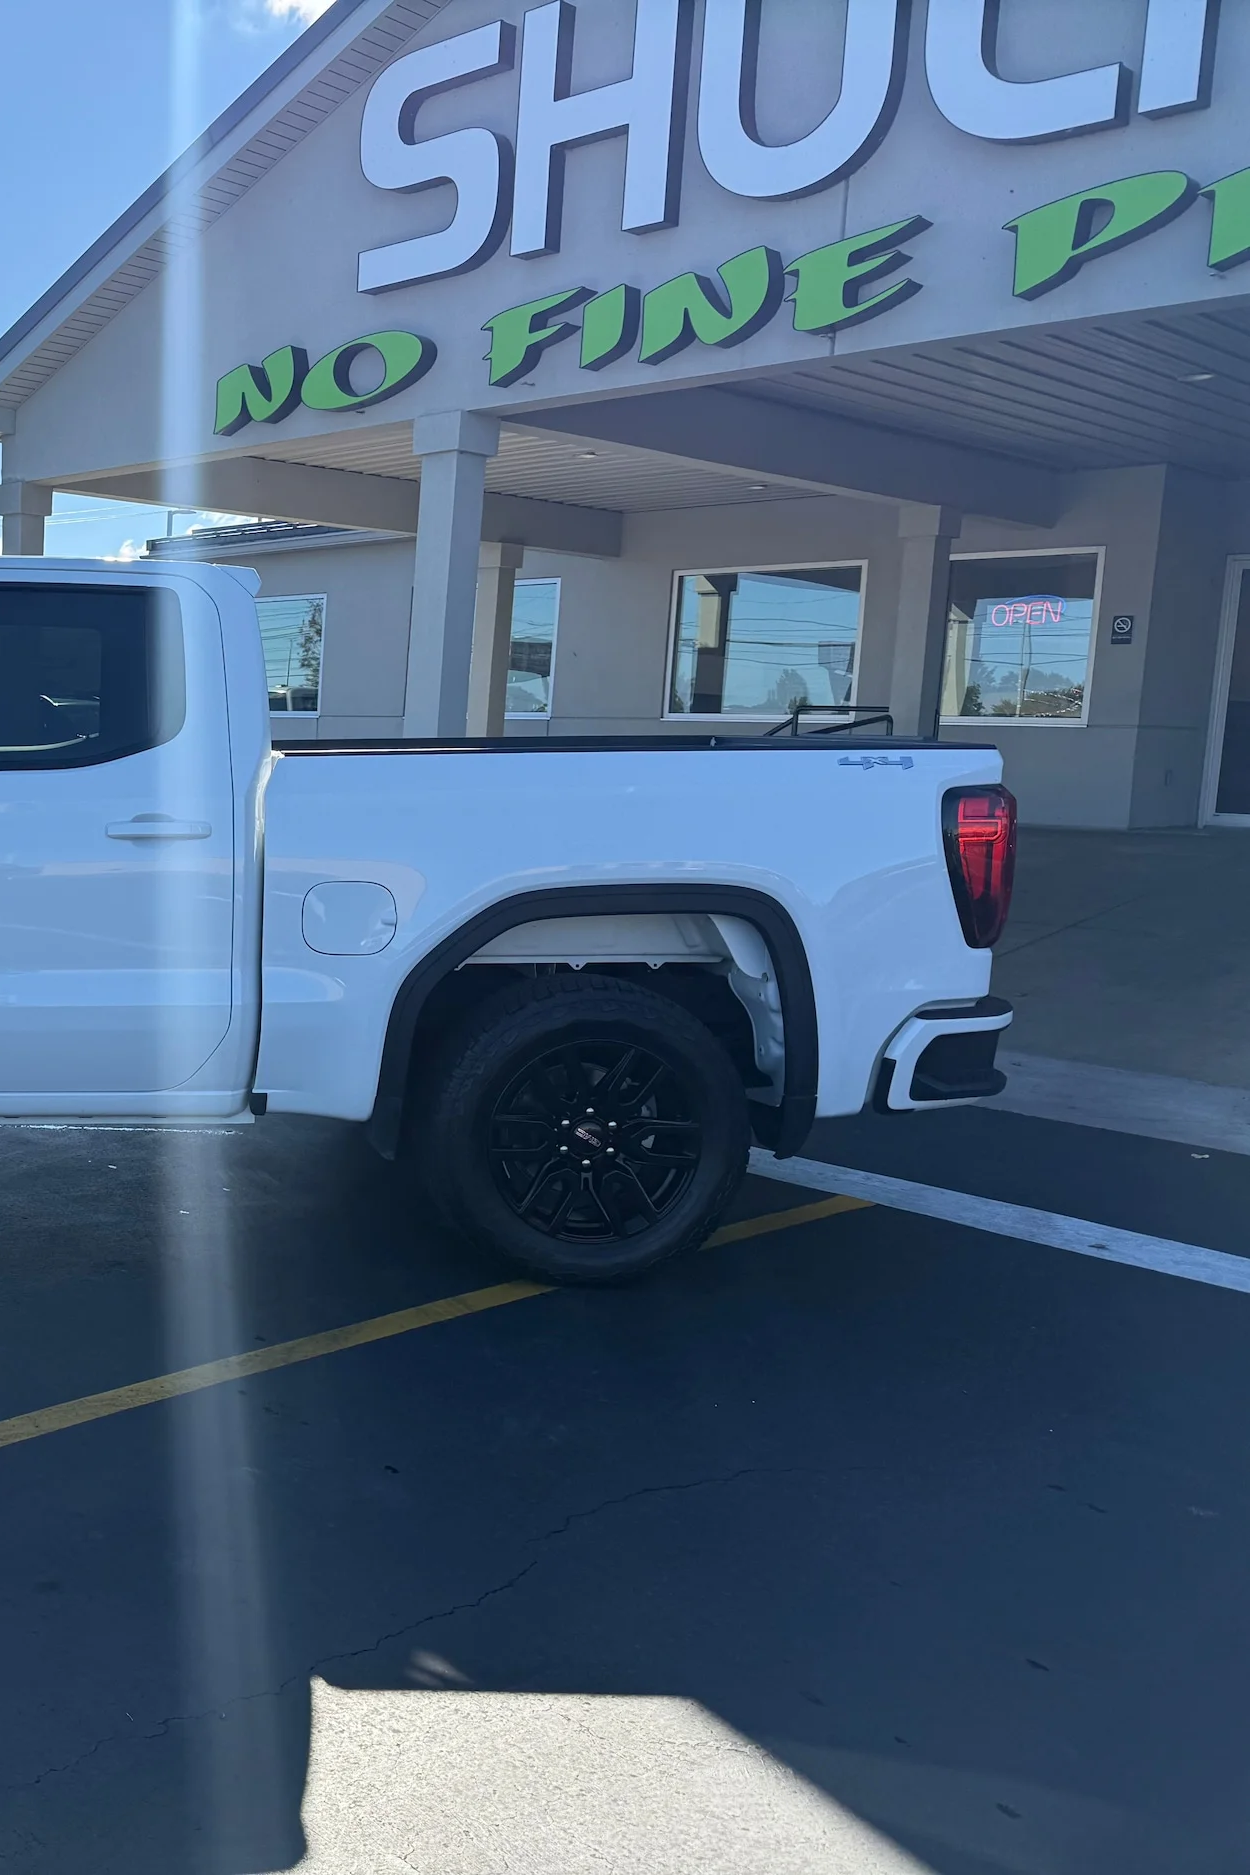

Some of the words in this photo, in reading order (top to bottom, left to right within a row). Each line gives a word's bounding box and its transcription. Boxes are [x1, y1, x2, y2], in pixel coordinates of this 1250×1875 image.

[357, 0, 1218, 294] SHUC
[214, 330, 436, 436] NO
[481, 215, 930, 388] FINE
[991, 601, 1062, 627] OPEN
